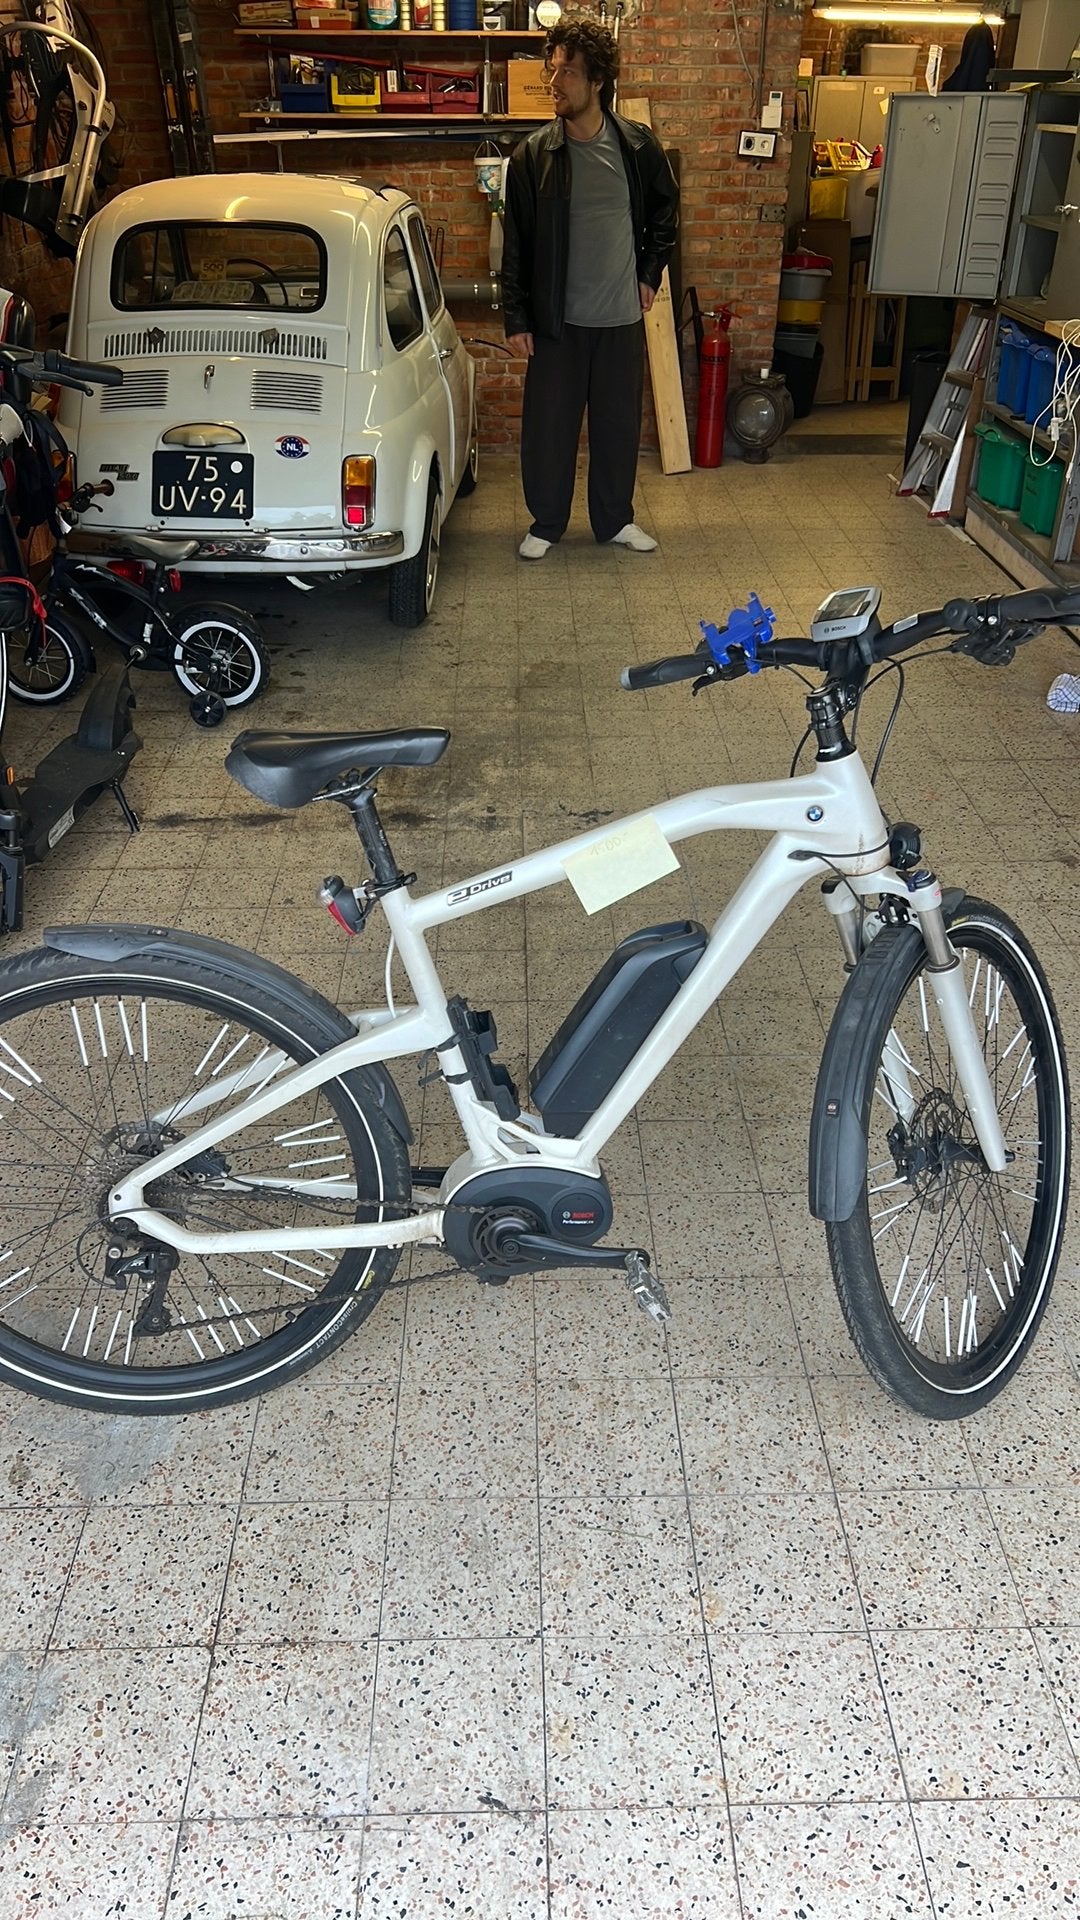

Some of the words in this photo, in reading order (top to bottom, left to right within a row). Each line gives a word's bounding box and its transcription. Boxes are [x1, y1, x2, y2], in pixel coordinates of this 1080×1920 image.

[286, 443, 299, 451] NL
[185, 455, 219, 482] 75
[159, 485, 247, 515] UV-94
